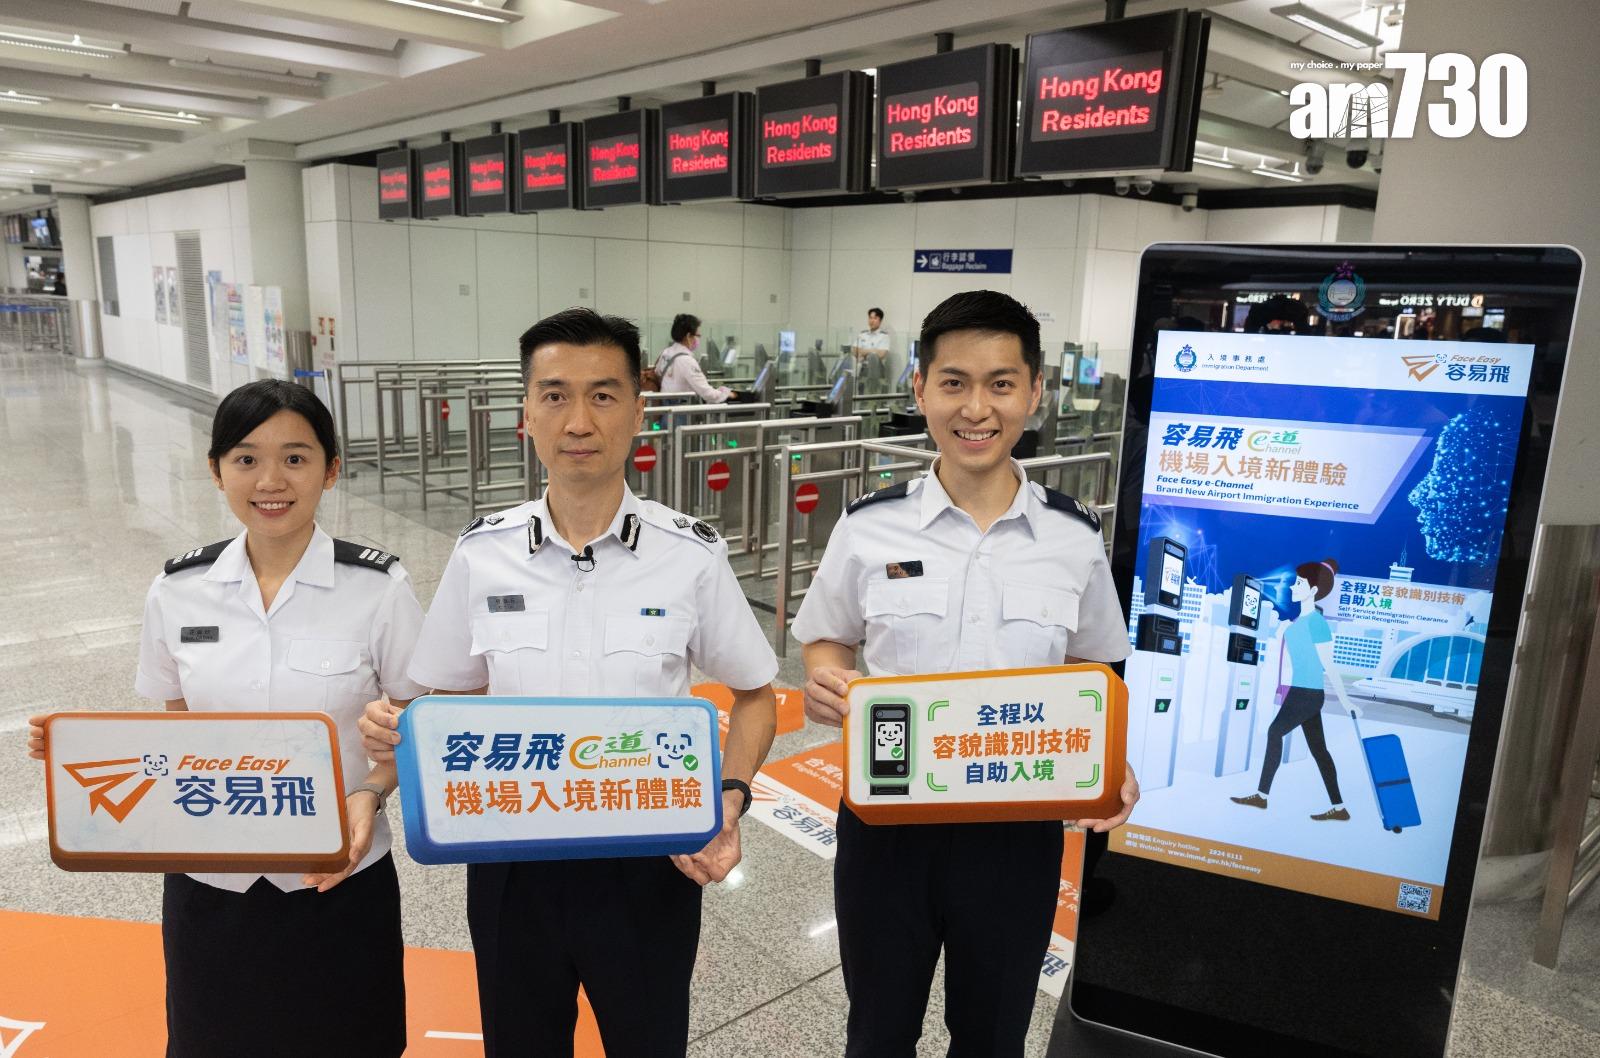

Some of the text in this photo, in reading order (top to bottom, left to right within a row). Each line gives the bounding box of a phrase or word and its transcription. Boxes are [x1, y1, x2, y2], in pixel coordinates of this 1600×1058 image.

[1040, 68, 1162, 100] Hong Kong
[887, 94, 978, 124] Hong Kong
[1041, 104, 1150, 132] Residents
[763, 114, 838, 139] Hong Kong
[669, 128, 729, 151] Hong Kong
[890, 126, 971, 152] Residents
[524, 151, 567, 170] Hong Kong
[591, 142, 640, 162] Hong Kong
[672, 154, 728, 173] Residents
[767, 142, 832, 163] Residents
[593, 165, 637, 182] Residents
[1235, 364, 1269, 372] Department
[1450, 354, 1501, 364] Face Easy
[1445, 363, 1511, 383] 容易飛
[1162, 423, 1244, 450] 容易飛
[1159, 449, 1348, 486] 機場入境新體驗
[1156, 474, 1254, 491] Face Easy e-Channel
[1156, 484, 1360, 511] Brand New Airport Immigration Experience
[1339, 593, 1392, 610] 自助入境
[1352, 613, 1371, 621] Facial
[1371, 615, 1409, 625] Recognition
[1376, 609, 1415, 620] Immigration
[1416, 614, 1449, 624] Clearance
[977, 702, 1046, 727] 全程以
[441, 731, 567, 772] 容易飛
[932, 727, 1091, 760] 容貌識別技術
[177, 755, 290, 775] Face Easy
[965, 760, 1055, 784] 自助入境
[173, 776, 317, 817] 容易飛
[444, 776, 703, 817] 機場入境新體驗
[1152, 837, 1177, 849] Enquiry
[1178, 841, 1200, 851] hotline
